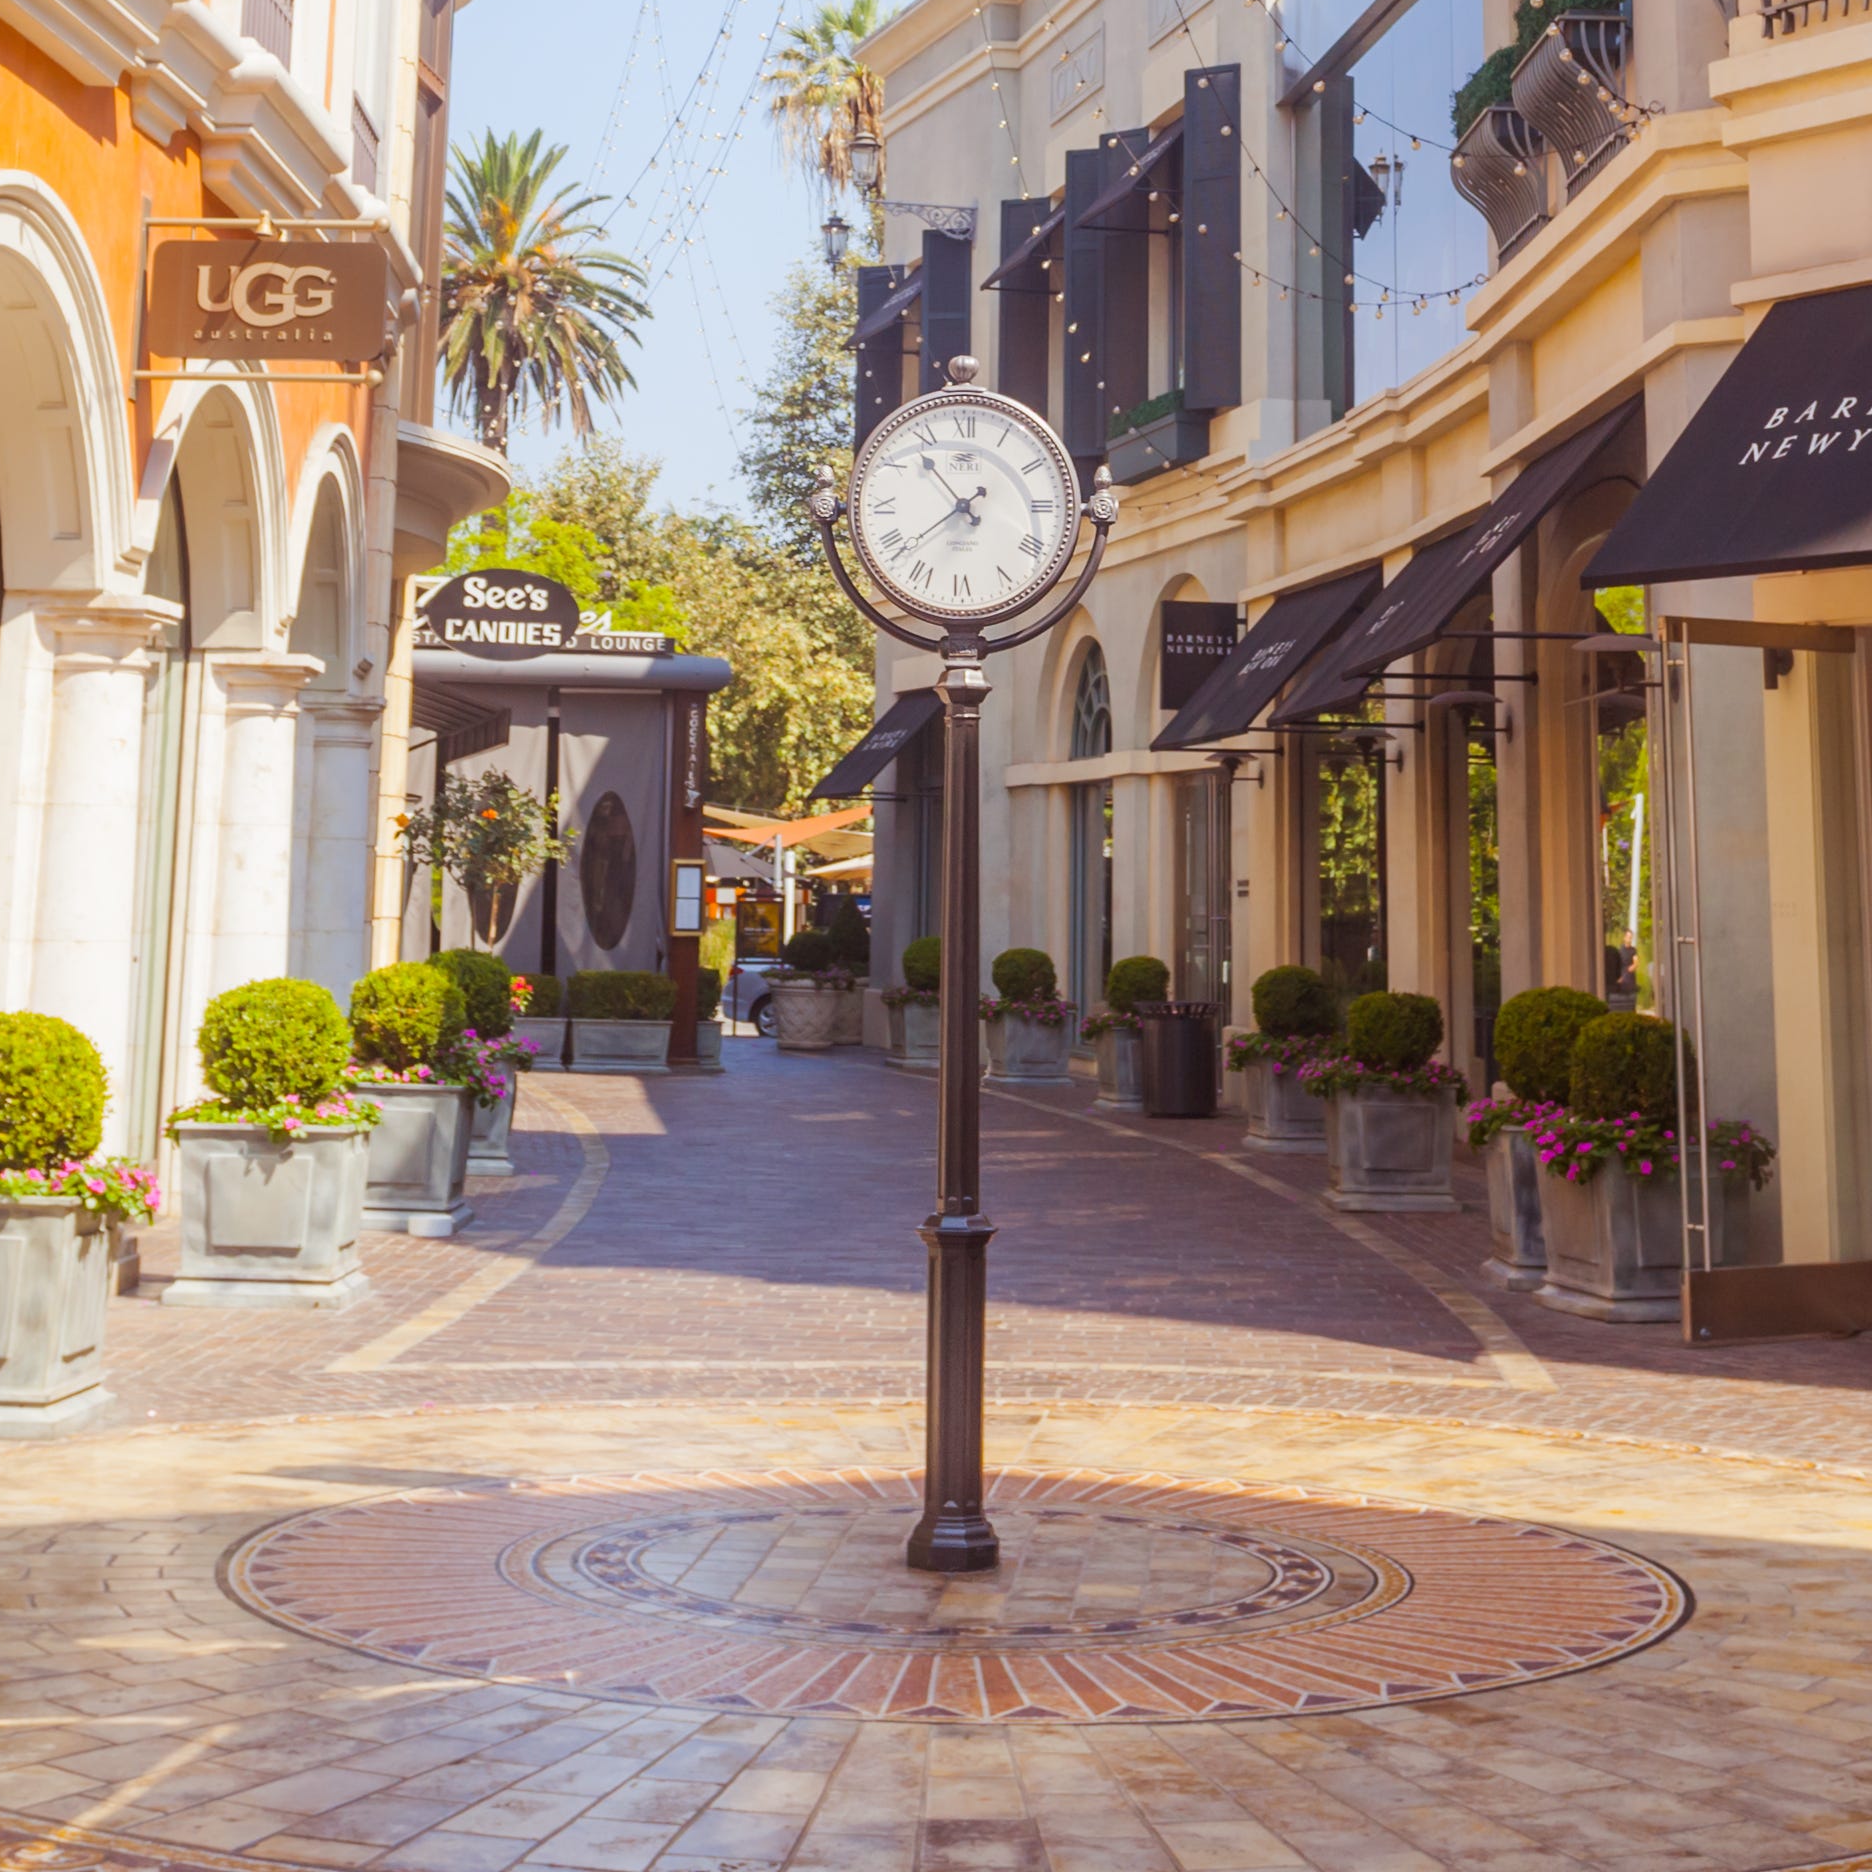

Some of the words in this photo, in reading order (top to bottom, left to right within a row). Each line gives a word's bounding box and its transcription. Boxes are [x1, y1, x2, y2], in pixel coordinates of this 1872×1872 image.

[196, 261, 336, 327] UGG
[193, 328, 333, 341] australia
[953, 416, 976, 438] XII
[1021, 458, 1044, 475] II
[1031, 499, 1053, 513] III
[909, 559, 934, 590] VII
[463, 576, 549, 612] See's
[444, 618, 562, 647] CANDIES
[1166, 633, 1234, 645] BARNEYS
[590, 636, 666, 651] LOUNGE
